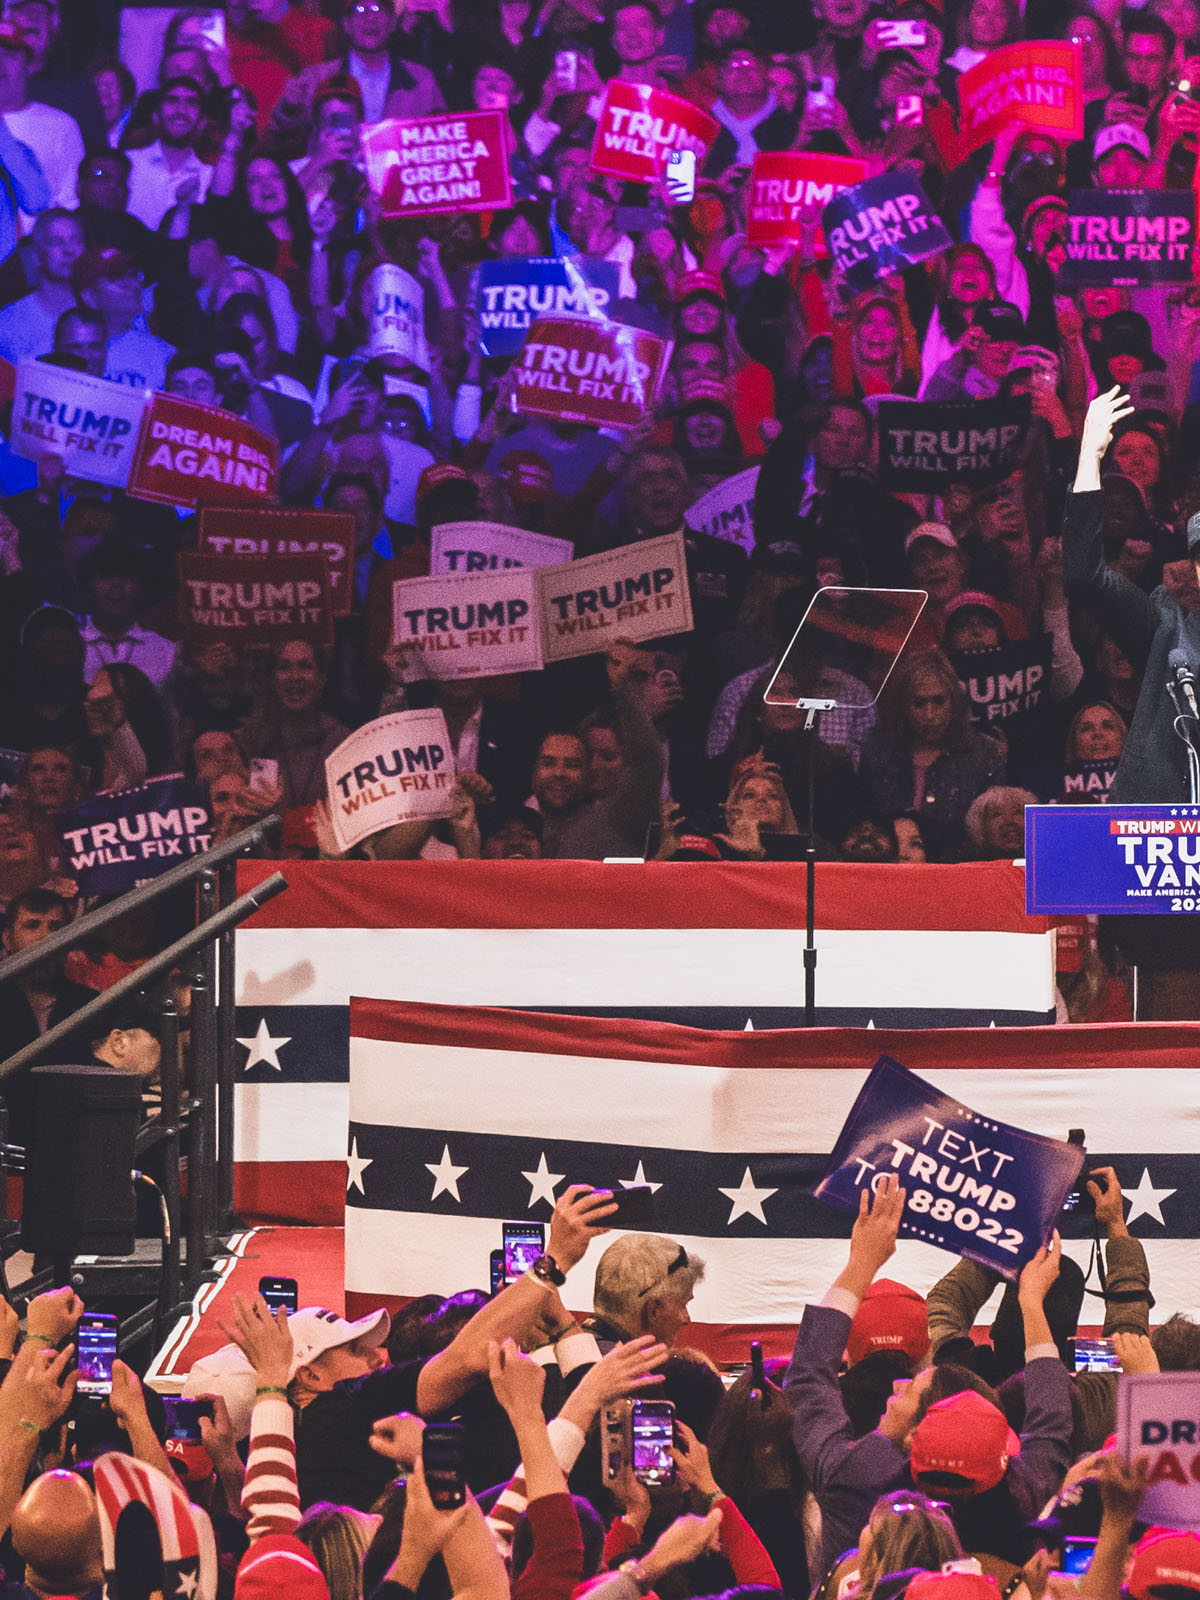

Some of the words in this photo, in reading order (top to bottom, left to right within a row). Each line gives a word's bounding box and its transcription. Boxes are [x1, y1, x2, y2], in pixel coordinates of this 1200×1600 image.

[401, 121, 468, 146] MAKE
[604, 132, 657, 159] WILL
[400, 161, 477, 186] GREAT
[400, 180, 481, 206] AGAIN!
[757, 179, 848, 206] TRUM
[868, 223, 907, 253] FIX
[1067, 215, 1190, 242] TRUMP
[1066, 243, 1120, 260] WILL
[1124, 243, 1162, 261] FIX
[1167, 243, 1189, 260] IT
[483, 284, 610, 312] TRUMP
[523, 343, 650, 385] TRUMP
[516, 367, 572, 393] WILL
[578, 379, 617, 401] FIX
[621, 386, 644, 405] IT
[25, 392, 131, 440] TRUMP
[65, 431, 103, 453] FIX
[151, 421, 233, 455] DREAM
[888, 425, 1018, 454] TRUMP
[149, 444, 268, 492] AGAIN!
[890, 455, 948, 472] WILL
[956, 455, 991, 471] FIX
[187, 580, 321, 608] TRUMP
[551, 567, 674, 619] TRUMP
[192, 608, 247, 626] WILL
[253, 608, 292, 625] FIX
[301, 607, 321, 624] IT
[404, 600, 528, 635] TRUMP
[553, 615, 612, 635] WILL
[616, 600, 651, 622] FIX
[655, 592, 675, 610] IT
[467, 628, 501, 646] FIX
[508, 626, 529, 643] IT
[987, 698, 1019, 720] FIX
[337, 744, 444, 798] TRUMP
[341, 783, 396, 816] WILL
[400, 775, 431, 793] FIX
[433, 772, 447, 789] IT
[63, 806, 209, 854] TRUMP
[1117, 821, 1175, 834] TRUMP
[70, 845, 136, 870] WILL
[141, 838, 183, 859] FIX
[189, 834, 211, 853] IT
[1127, 889, 1152, 897] MAKE
[921, 1116, 1014, 1178] TEXT
[890, 1138, 1016, 1213] TRUMP
[908, 1189, 1024, 1254] 88022
[871, 1336, 903, 1345] TRUMP
